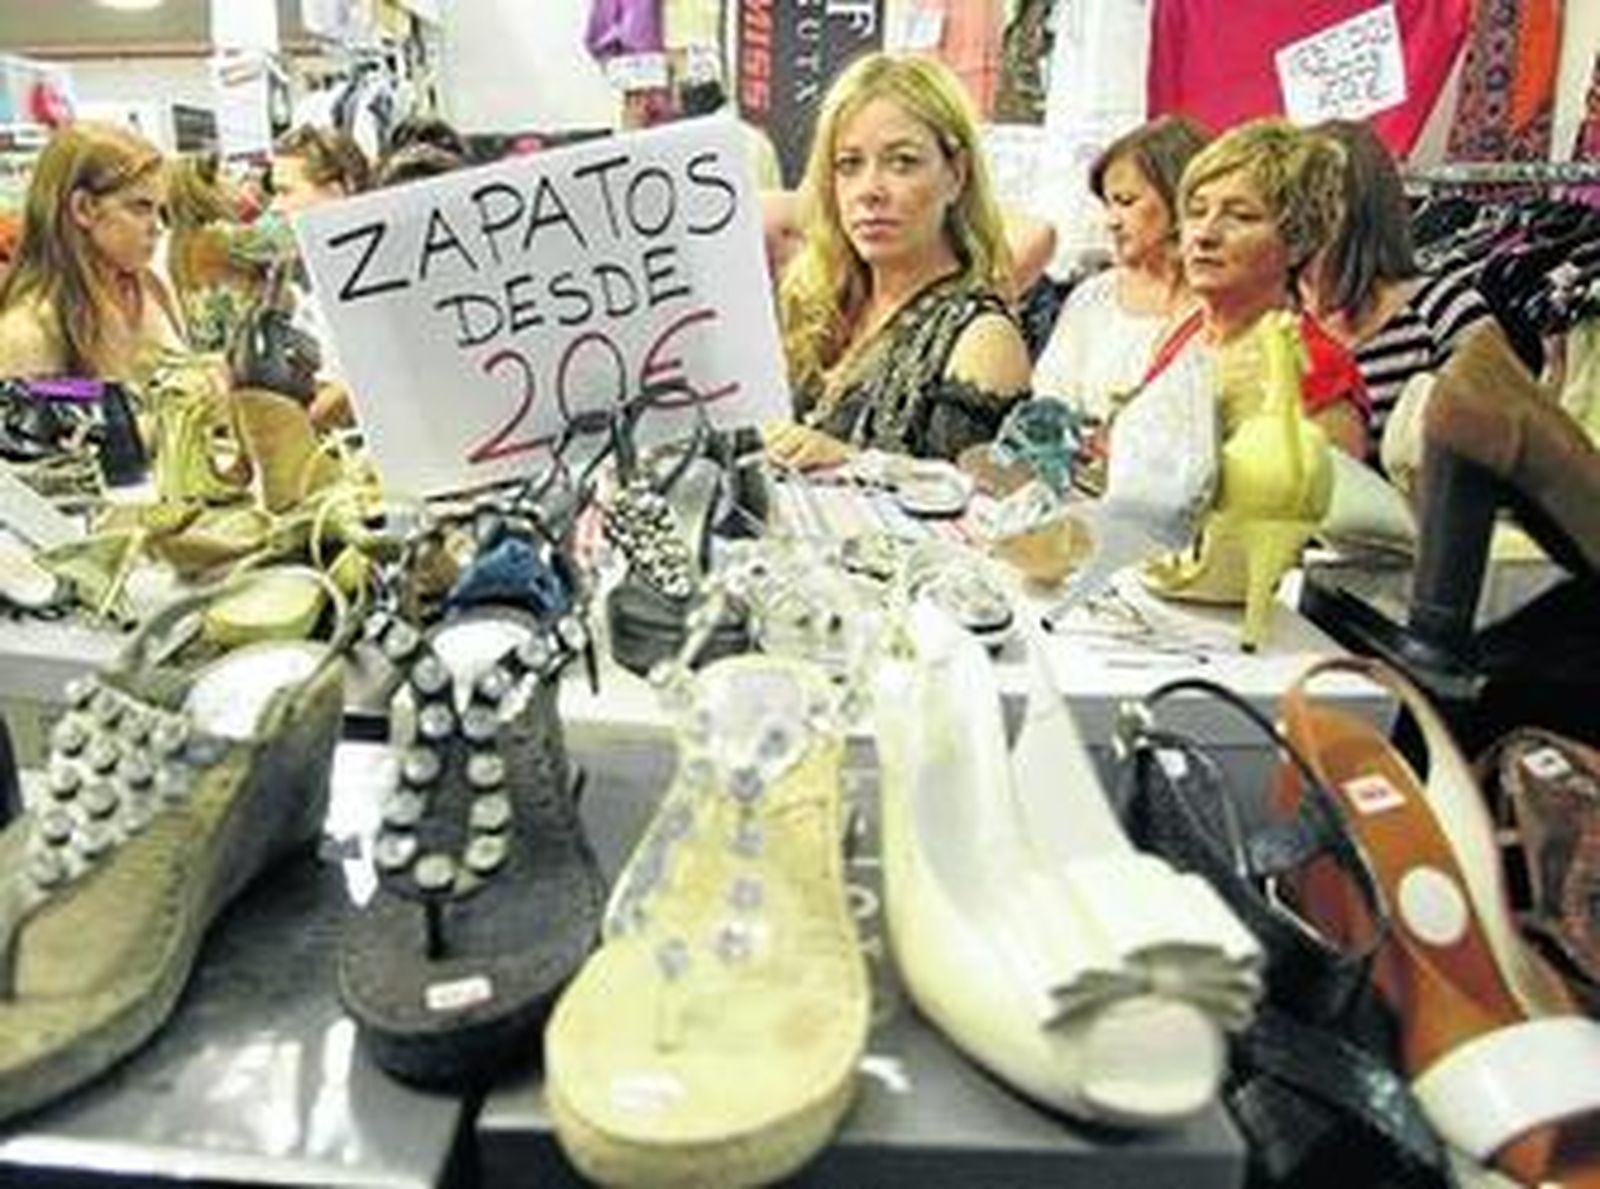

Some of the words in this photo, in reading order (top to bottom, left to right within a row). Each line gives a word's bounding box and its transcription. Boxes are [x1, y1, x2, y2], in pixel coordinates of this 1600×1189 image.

[328, 152, 738, 302] ZAPATOS
[434, 246, 691, 348] DESDE
[467, 309, 740, 465] 20€
